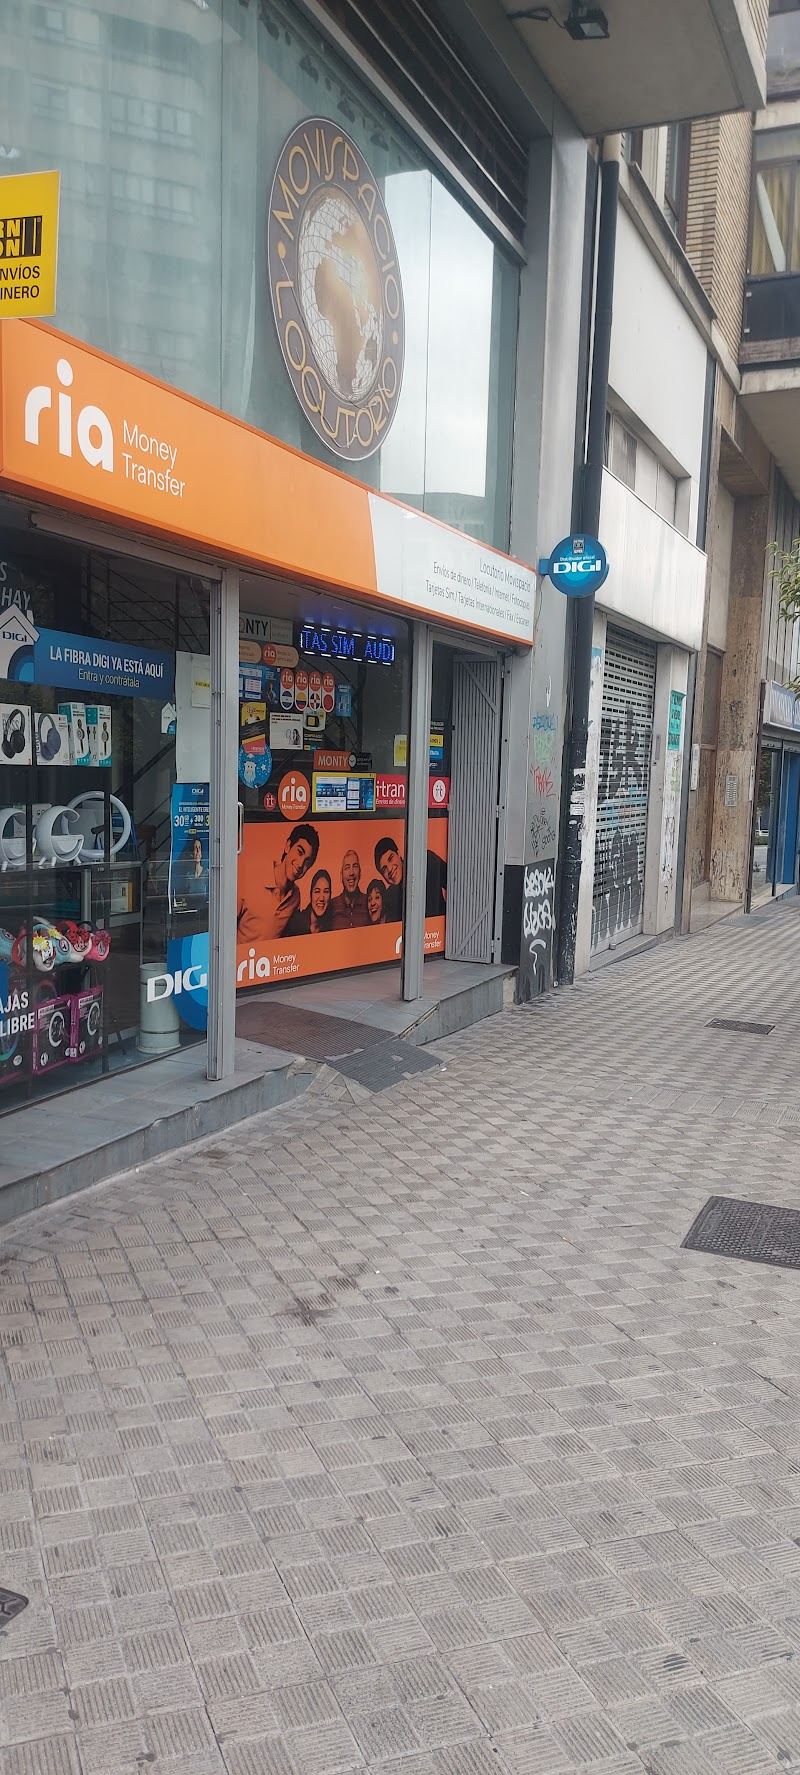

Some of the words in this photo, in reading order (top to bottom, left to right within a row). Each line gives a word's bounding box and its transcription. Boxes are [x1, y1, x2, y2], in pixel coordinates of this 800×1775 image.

[272, 127, 400, 321] MOVISPACIO
[275, 280, 398, 449] LOCUTORIO
[25, 358, 114, 473] ria
[123, 419, 177, 469] Money
[122, 452, 186, 498] Transfer
[480, 558, 504, 582] Locutorio
[504, 569, 531, 593] Movispacio
[553, 560, 602, 574] DIGI
[2, 586, 31, 611] HAY
[426, 580, 445, 597] Tarjetas
[445, 587, 455, 600] Sim
[458, 592, 475, 608] Tarjetas
[450, 571, 457, 581] de
[457, 572, 471, 587] dinero
[494, 588, 509, 602] Internet
[3, 631, 28, 642] DIGI
[331, 634, 355, 656] SIM
[50, 645, 62, 661] LA
[64, 649, 91, 666] FIBRA
[93, 653, 110, 669] DIGI
[111, 655, 123, 671] YA
[123, 656, 144, 675] ESTÁ
[145, 660, 164, 678] AQUÍ
[264, 645, 276, 658] ria
[78, 668, 98, 683] Entra
[99, 674, 104, 685] y
[104, 671, 140, 689] contrátala
[282, 672, 293, 683] ria
[296, 673, 307, 684] ria
[310, 674, 321, 685] ria
[323, 676, 334, 687] ria
[317, 755, 348, 767] MONTY
[281, 777, 307, 802] ria
[174, 815, 185, 827] 30
[237, 948, 270, 981] ria
[273, 953, 297, 964] Money
[272, 963, 300, 975] Transfer
[0, 1011, 36, 1038] LIBRE
